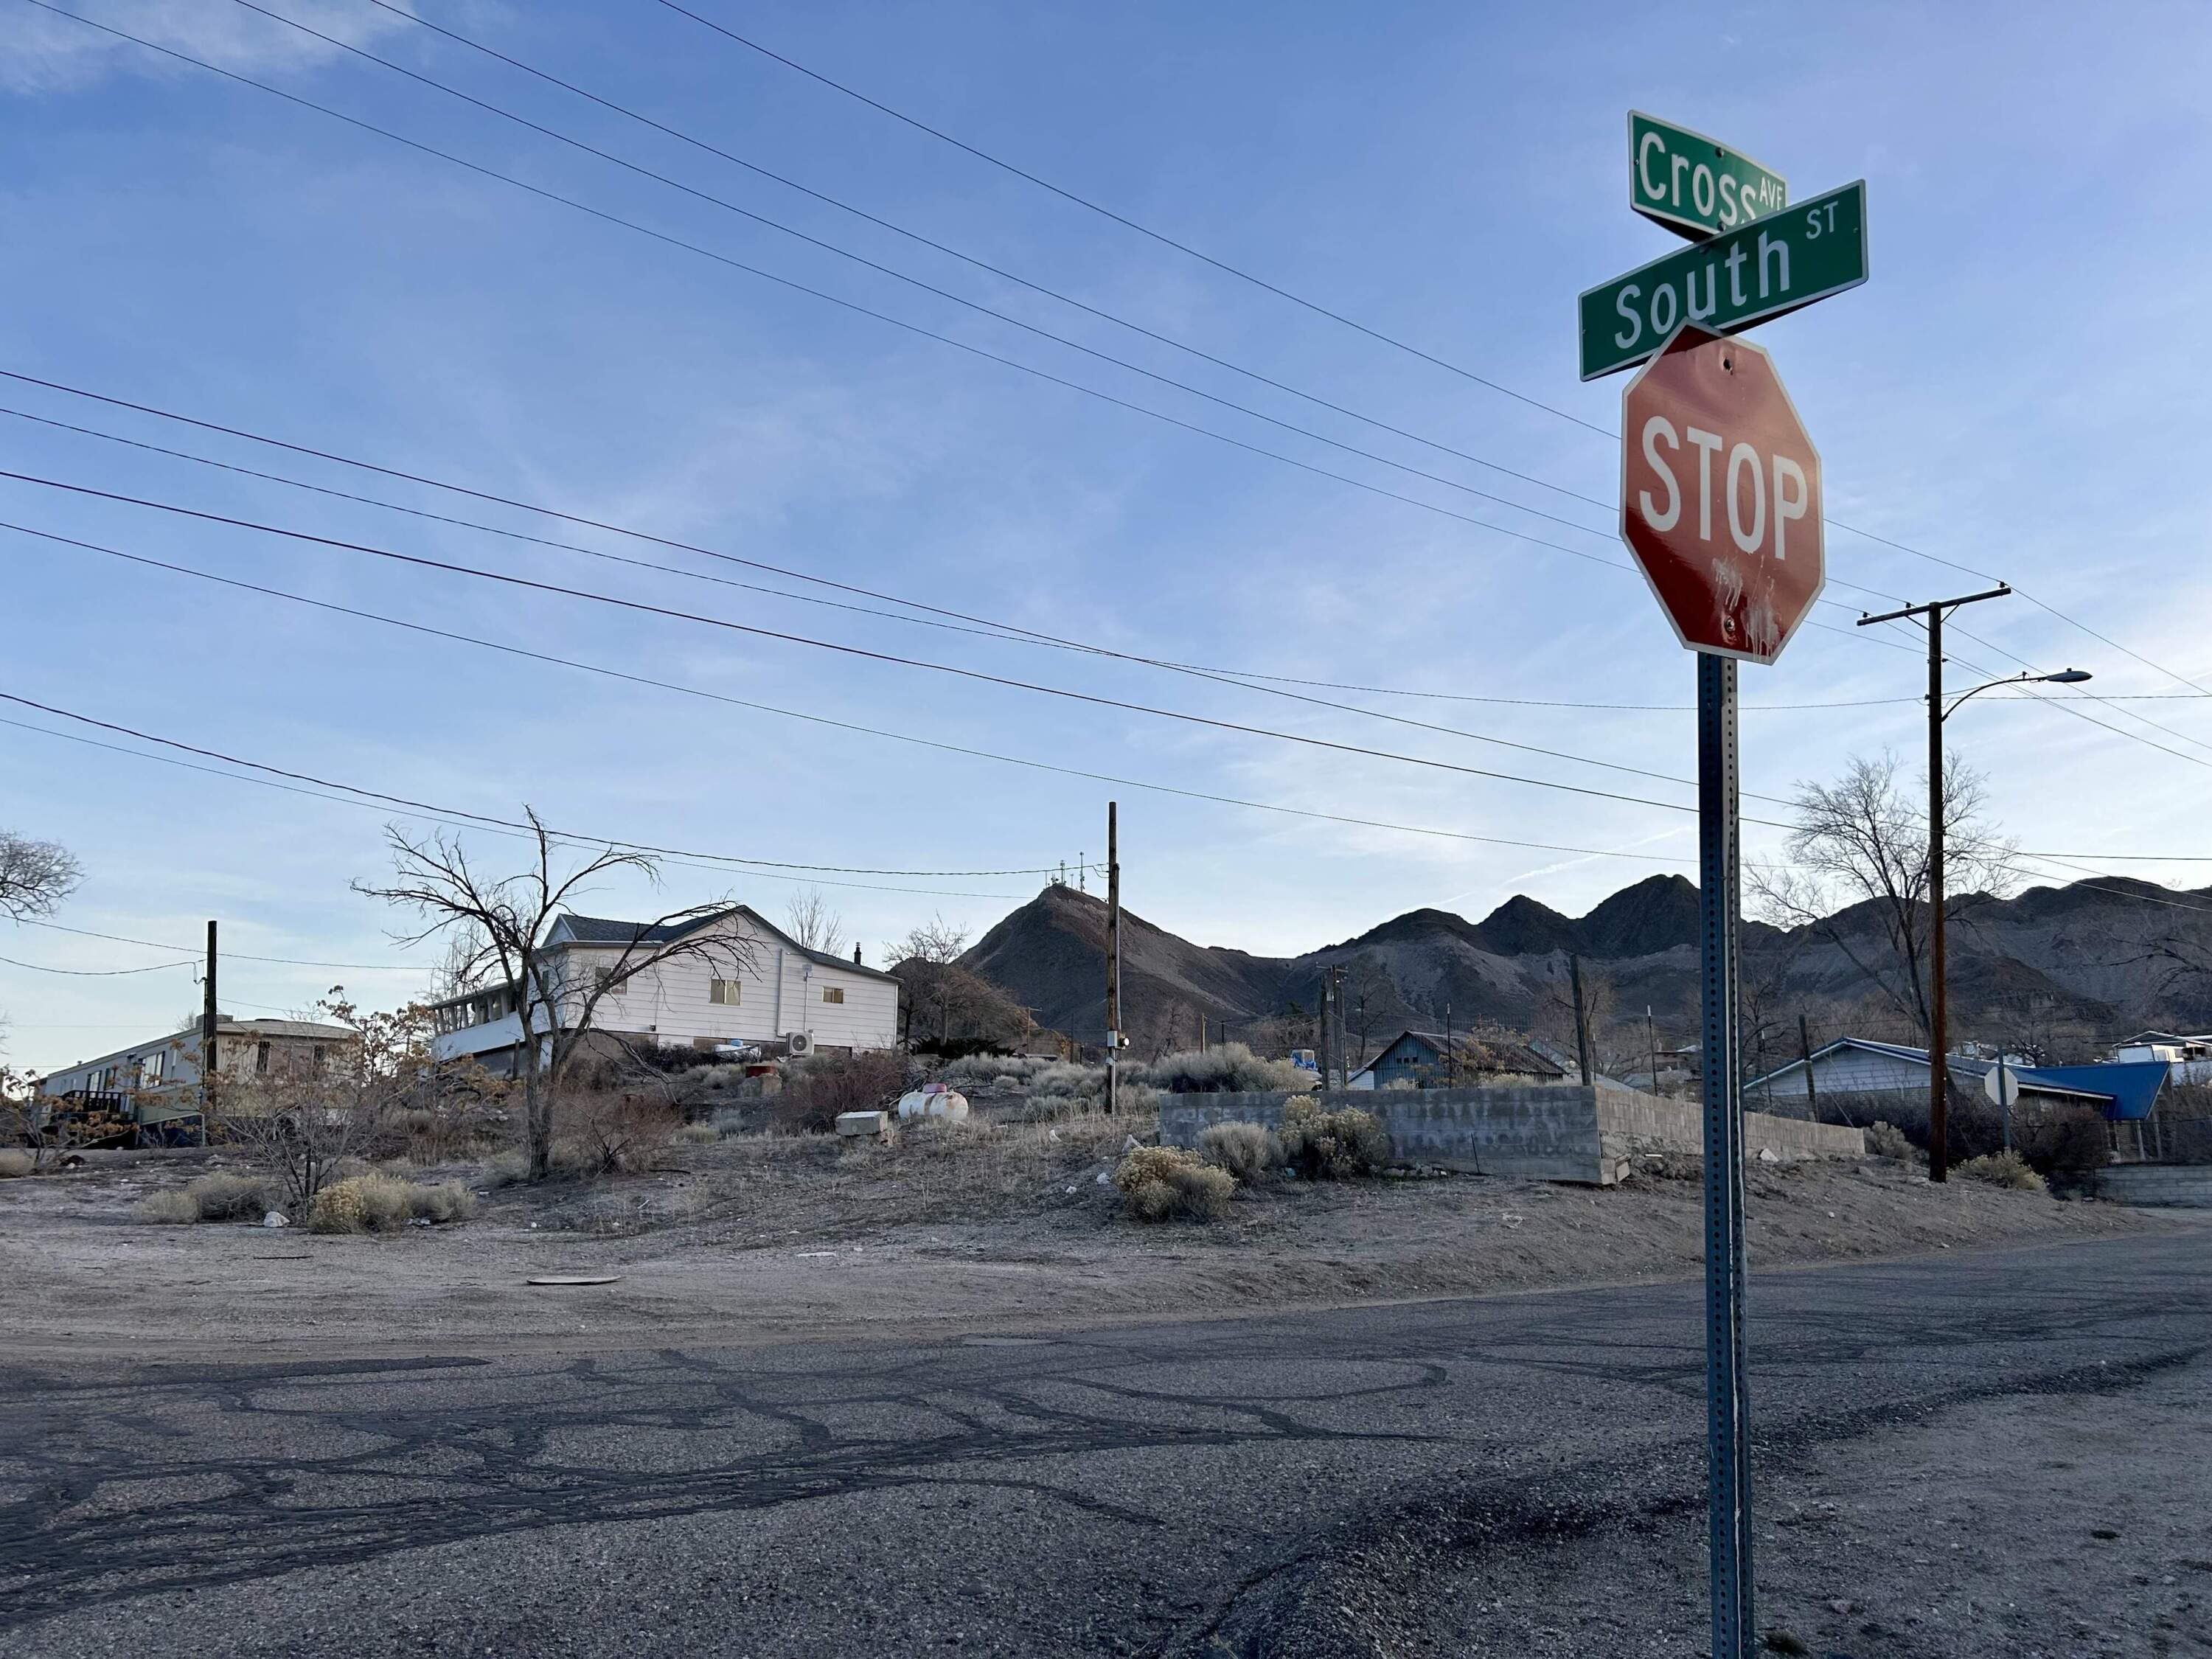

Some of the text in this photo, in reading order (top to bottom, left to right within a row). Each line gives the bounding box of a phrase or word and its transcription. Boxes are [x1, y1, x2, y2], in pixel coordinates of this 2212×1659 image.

[1640, 132, 1757, 226] Cross
[1615, 201, 1839, 349] South ST
[1639, 416, 1807, 560] STOP
